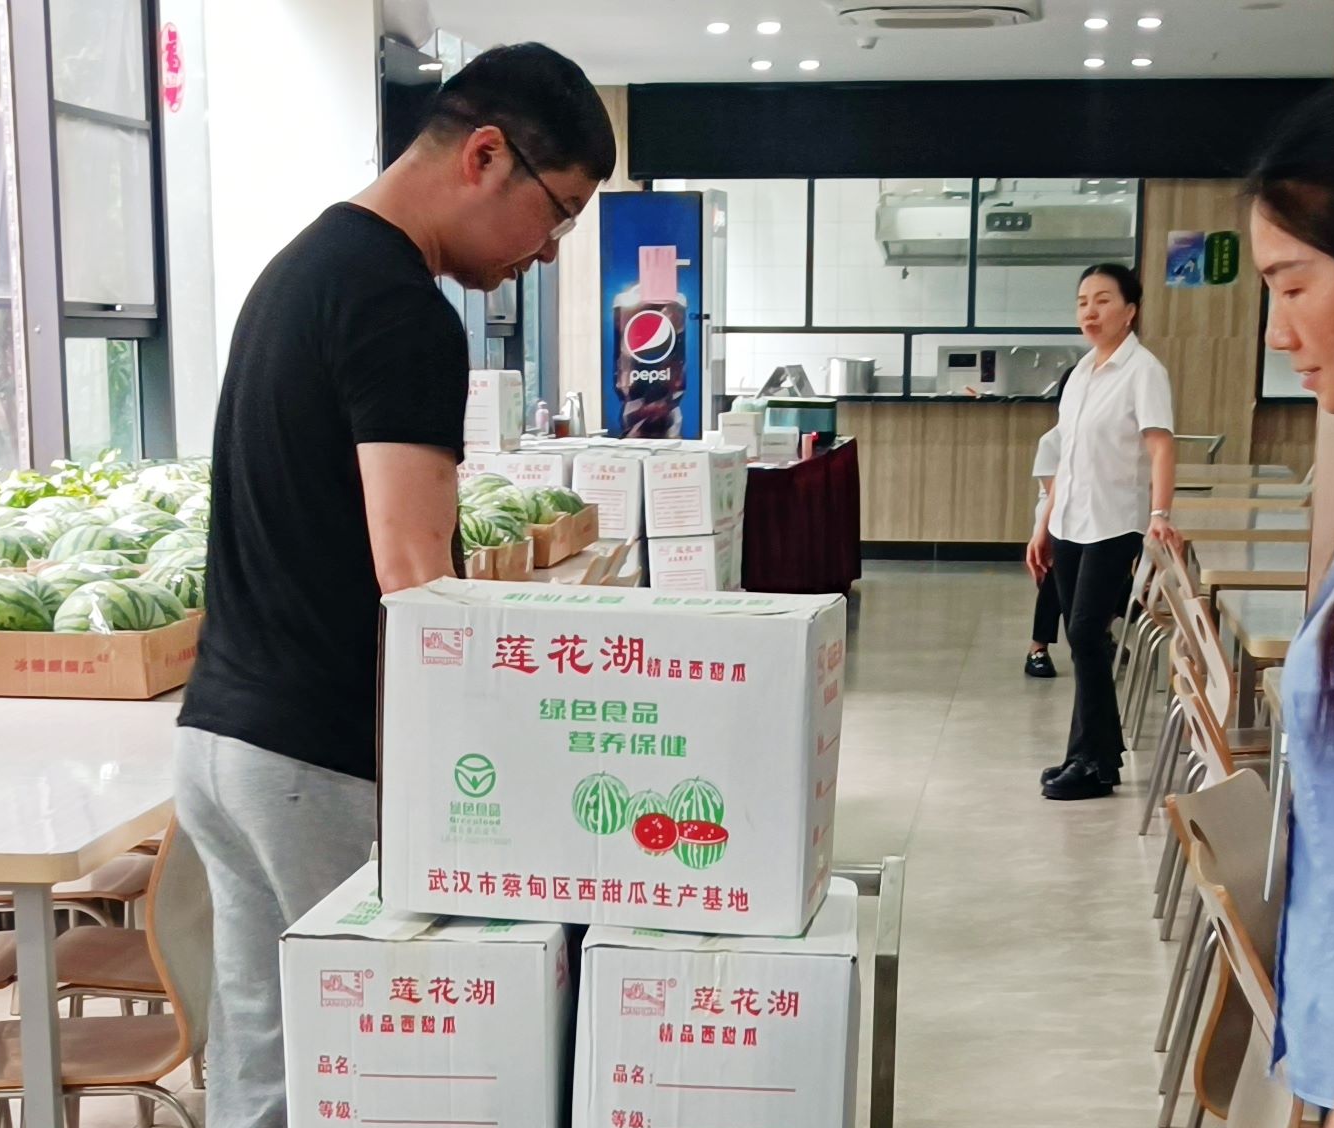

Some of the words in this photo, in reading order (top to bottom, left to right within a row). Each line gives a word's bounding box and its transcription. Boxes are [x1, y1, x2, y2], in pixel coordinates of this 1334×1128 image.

[629, 368, 670, 386] pepsi
[492, 634, 644, 675] 莲花湖
[647, 657, 746, 682] 精品西甜瓜
[539, 698, 659, 725] 绿色食品
[569, 731, 687, 757] 营养保健
[428, 867, 749, 912] 武汉市蔡甸区西甜瓜生产基地
[389, 976, 495, 1005] 莲花湖
[690, 986, 800, 1017] 莲花湖
[359, 1014, 456, 1034] 精品西甜瓜
[659, 1023, 757, 1046] 精品西甜瓜
